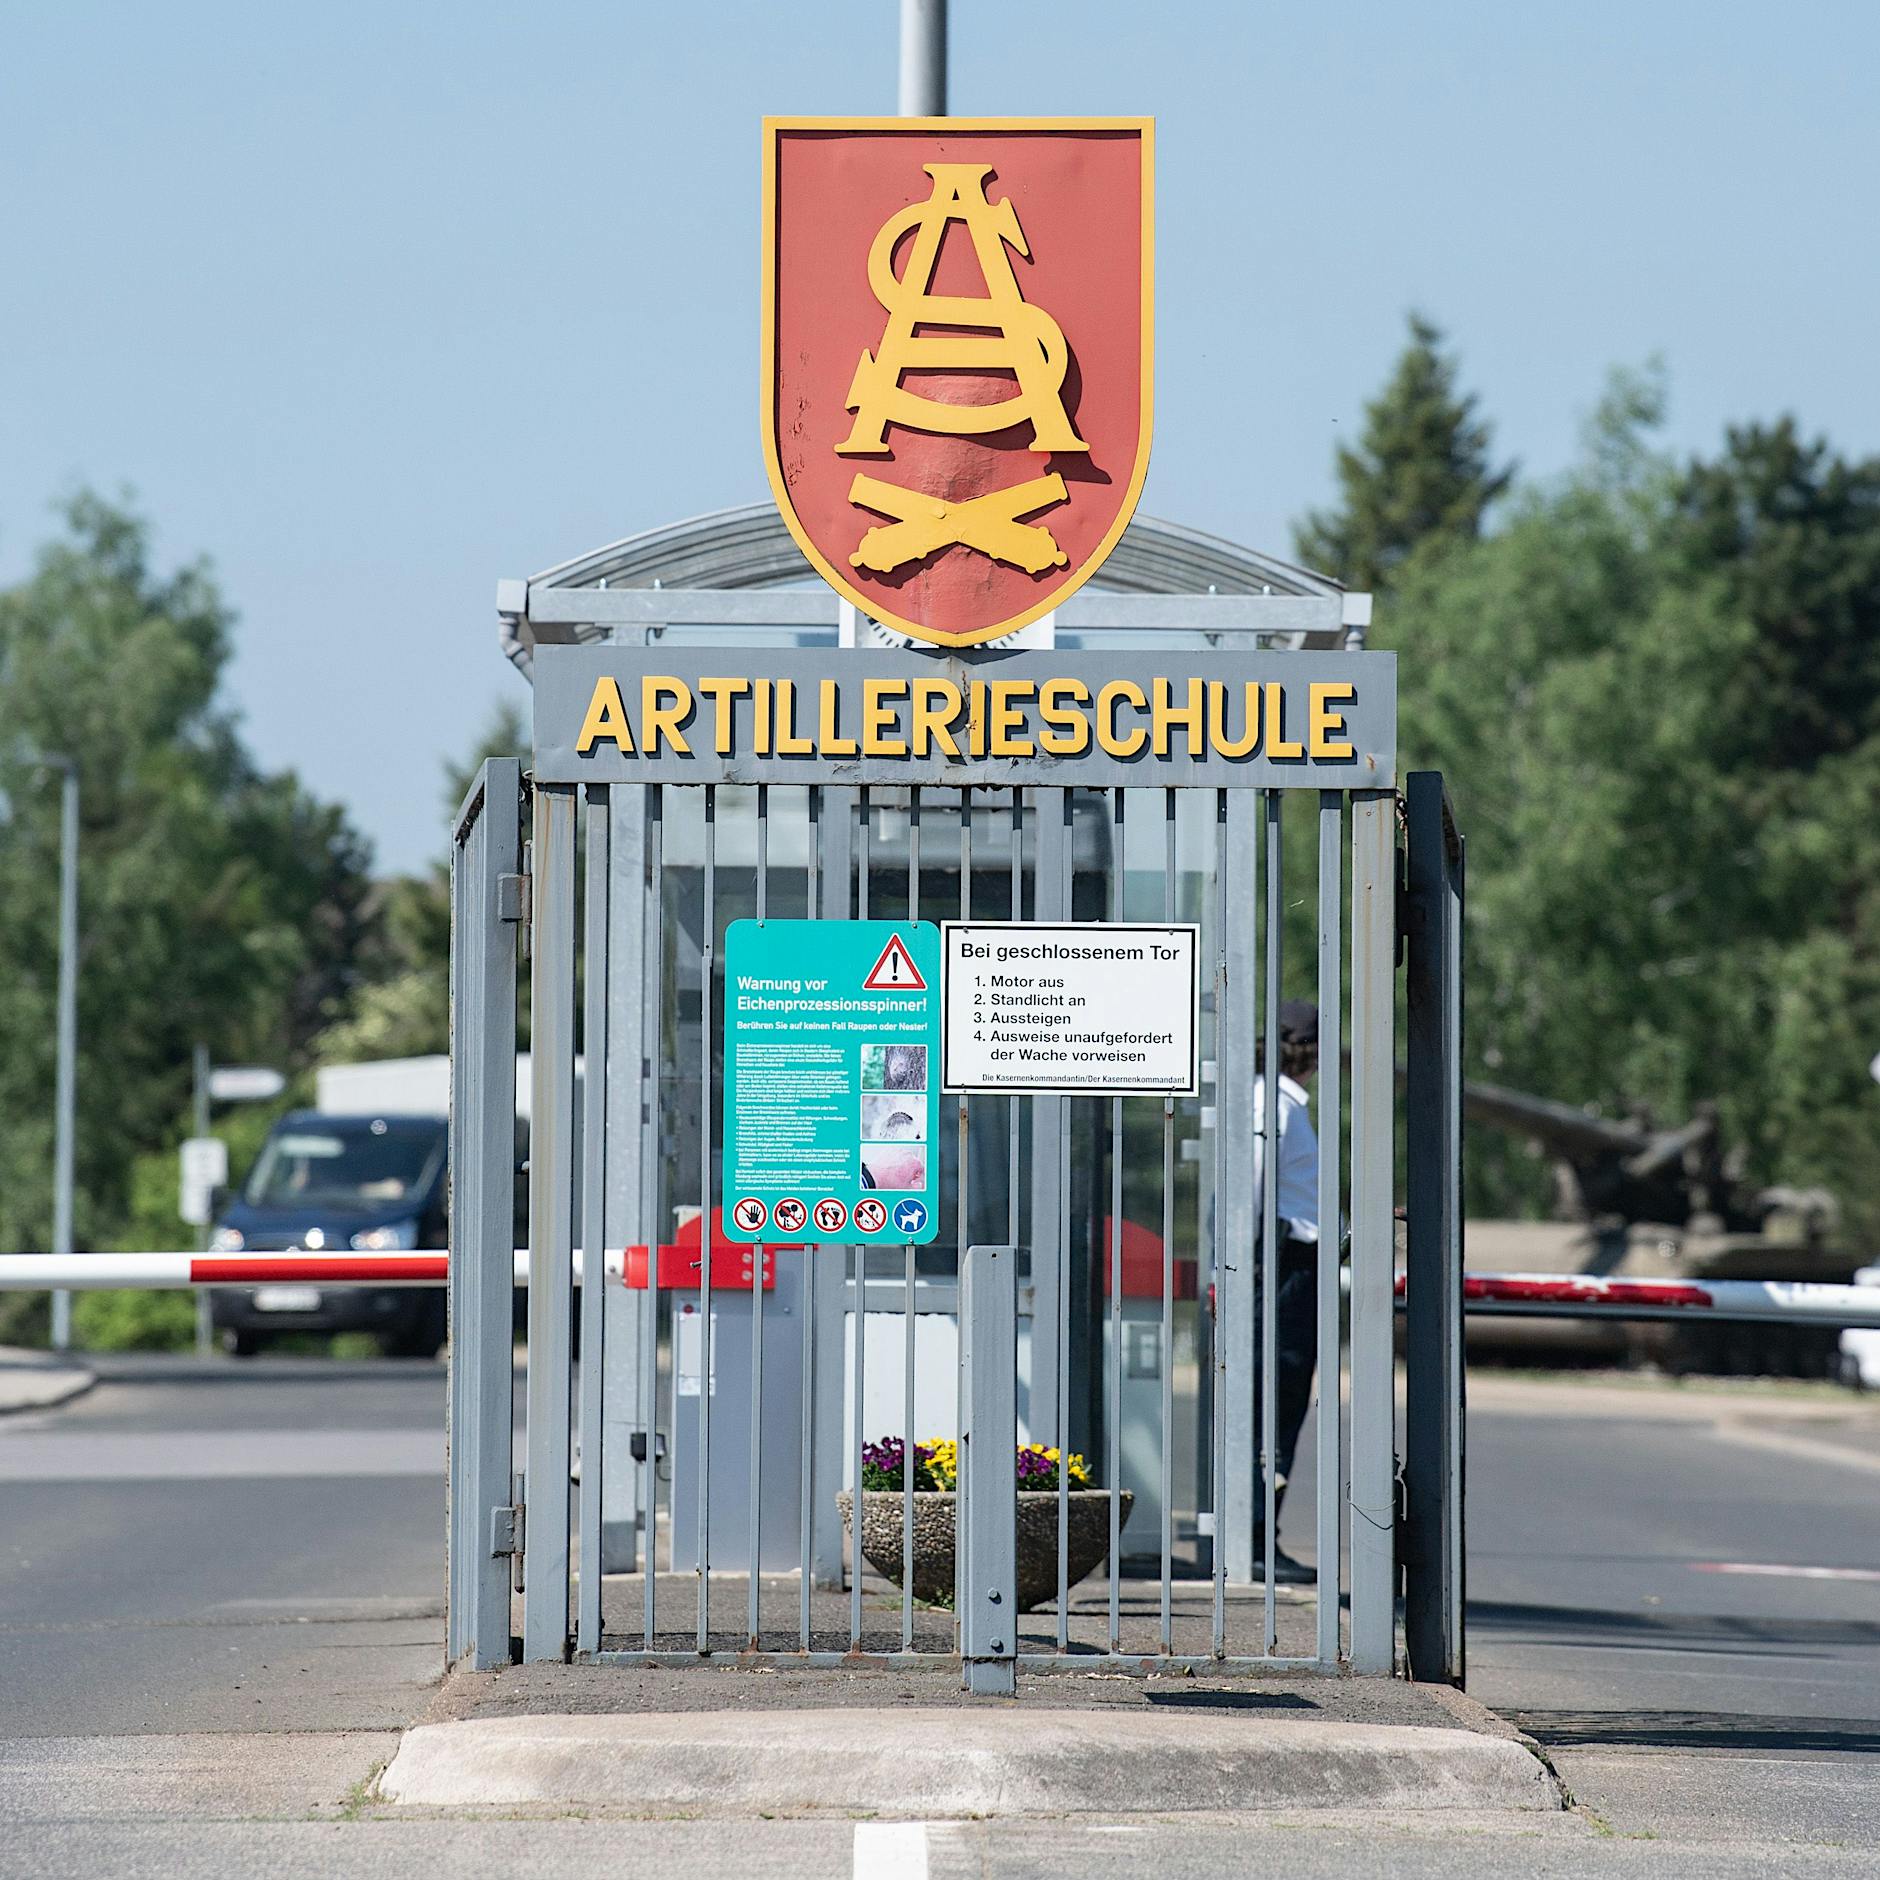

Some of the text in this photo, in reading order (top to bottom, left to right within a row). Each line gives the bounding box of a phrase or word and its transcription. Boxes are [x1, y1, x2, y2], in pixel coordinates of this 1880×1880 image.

[576, 676, 1354, 760] ARTILLERIESCHULE
[962, 943, 1180, 961] Bei geschlossenem Tor
[738, 977, 827, 993] Warnung vor
[975, 976, 1064, 987] 1. Motor aus
[738, 996, 926, 1014] Eichenprozessionsspinner!
[974, 994, 1085, 1006] 2. Standlicht an
[737, 1021, 773, 1029] Berühren
[832, 1022, 846, 1030] Fall
[848, 1022, 877, 1031] Raupen
[974, 1012, 1070, 1026] 3. Aussteigen
[974, 1031, 1172, 1045] 4. Ausweise unaufgefordert
[991, 1049, 1145, 1061] der Wache vorweisen
[1103, 1075, 1184, 1083] Kasernenkommandant
